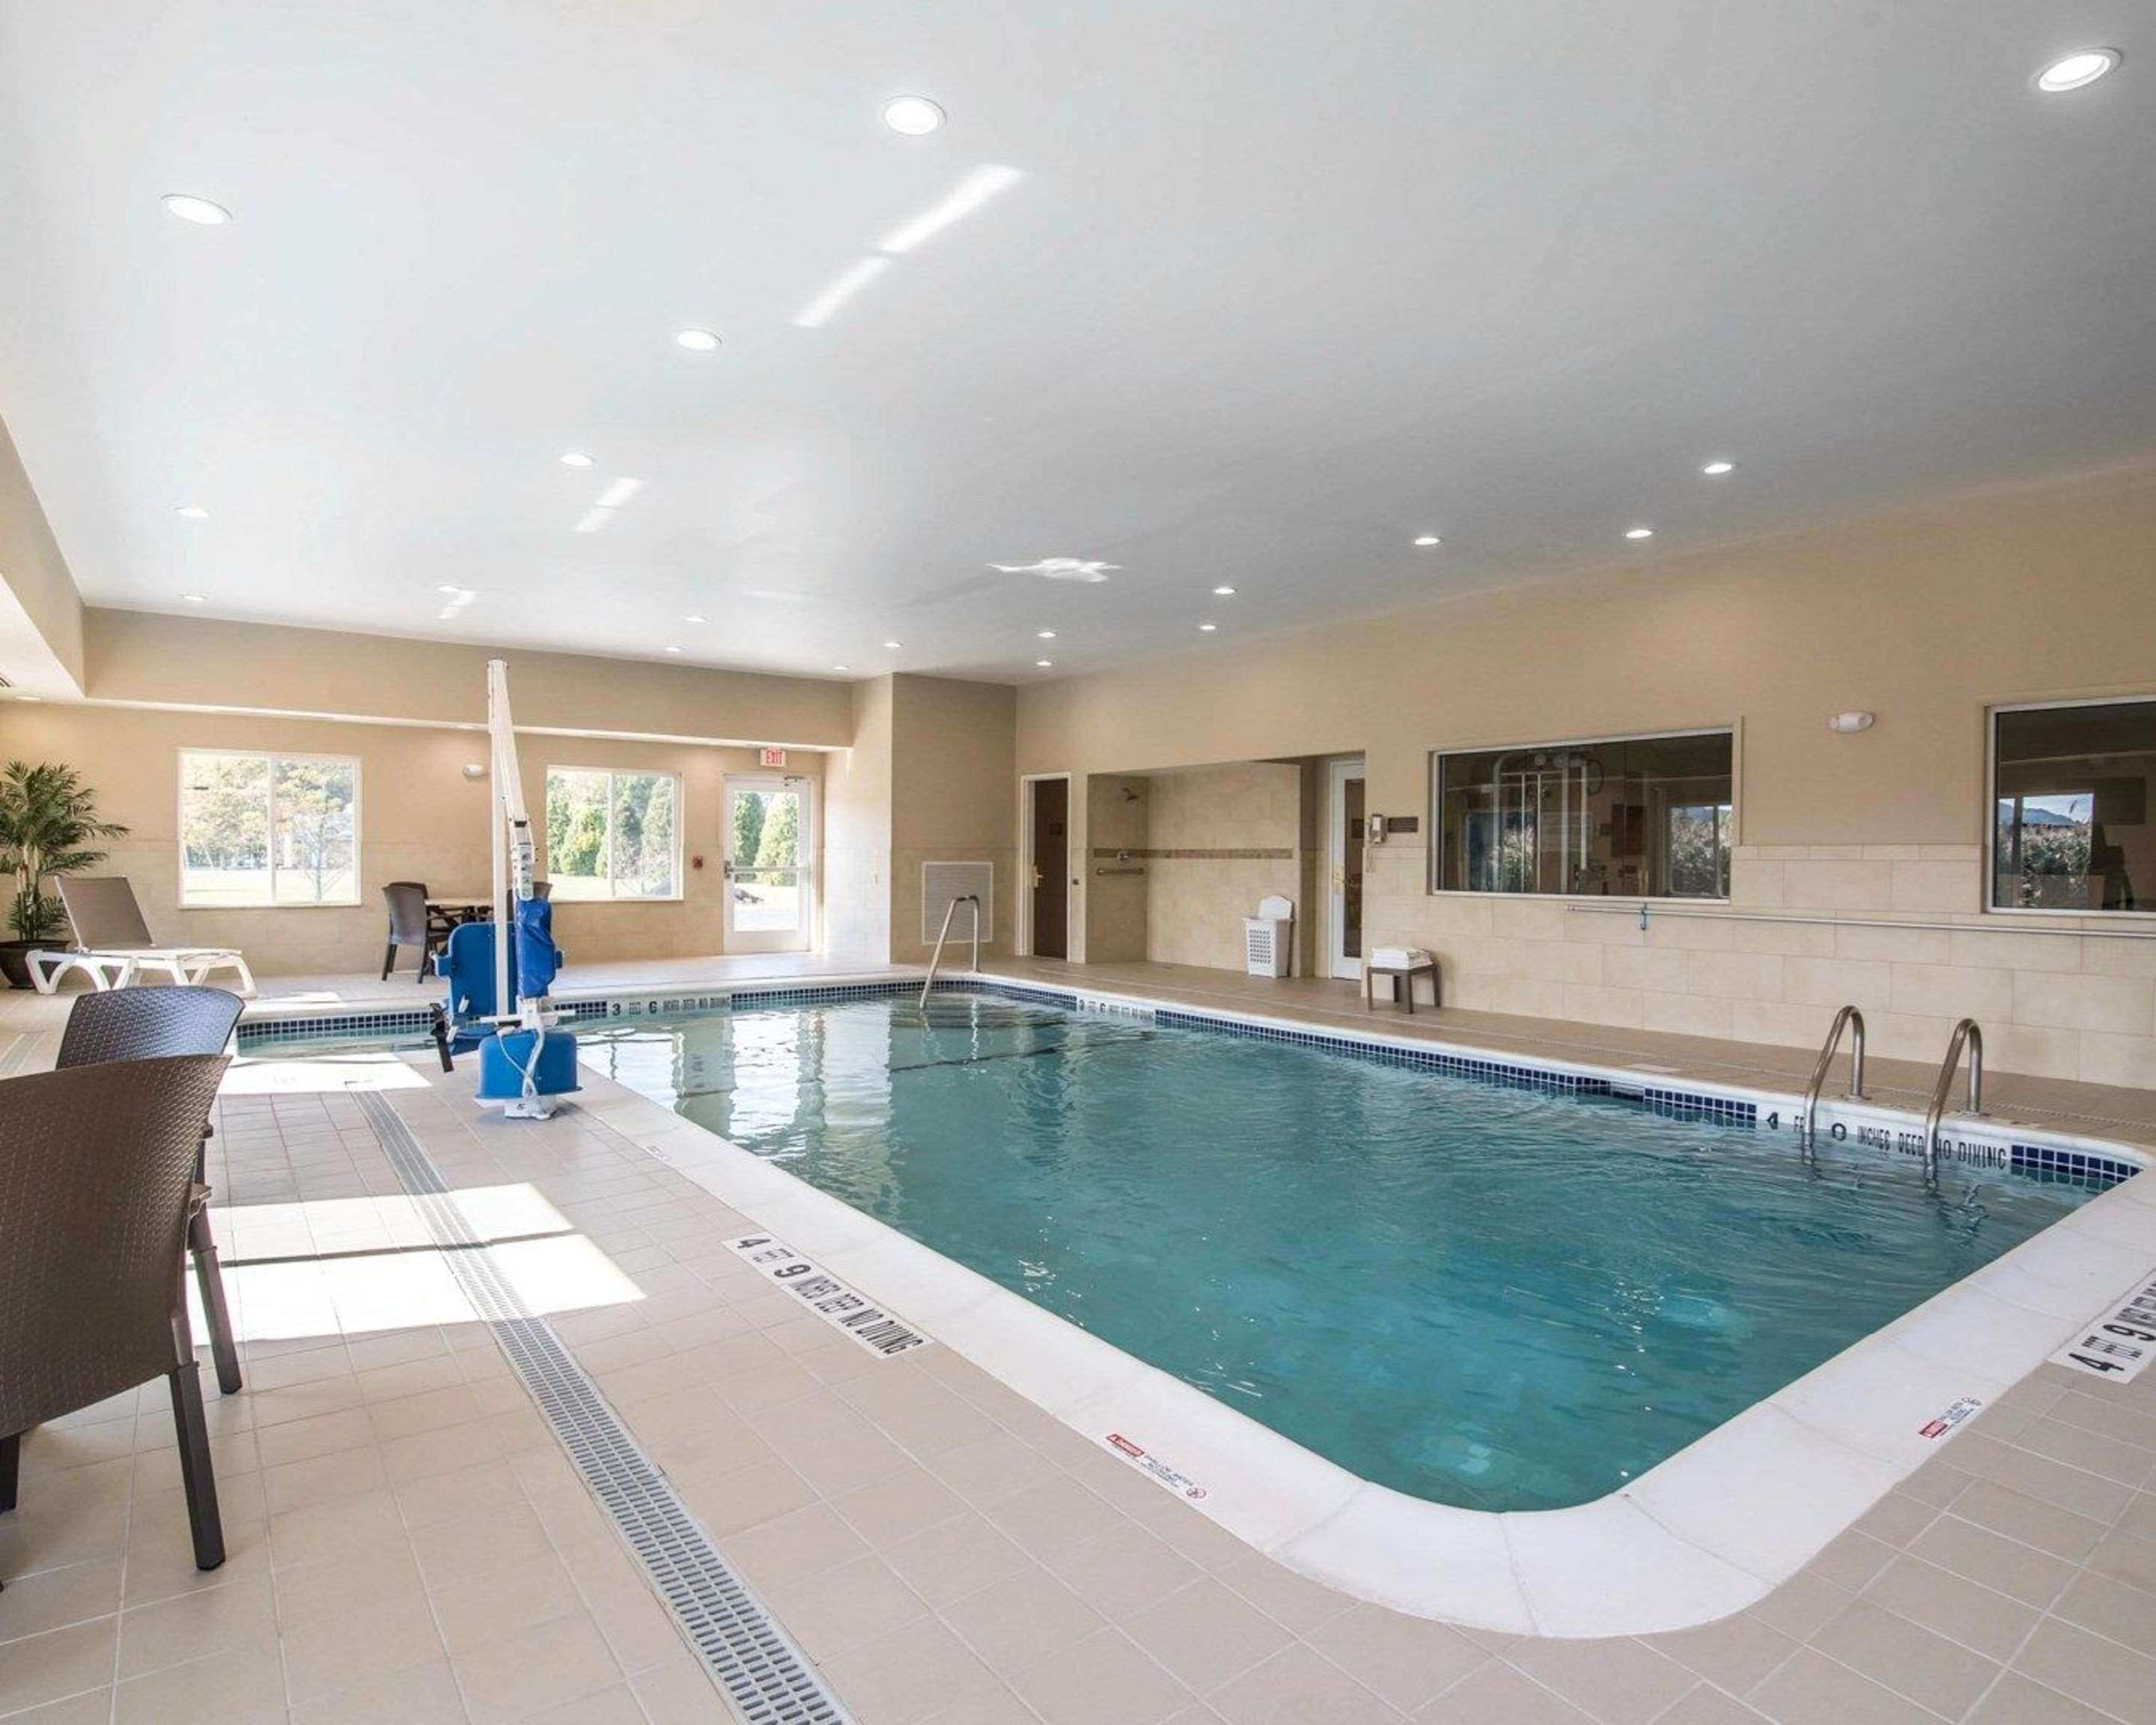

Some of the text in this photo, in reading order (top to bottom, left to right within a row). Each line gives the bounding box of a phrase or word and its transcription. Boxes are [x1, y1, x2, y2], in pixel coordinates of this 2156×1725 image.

[767, 750, 782, 764] EXIT
[612, 1003, 621, 1016] 3
[1857, 1125, 1890, 1151] INCHES
[1958, 1142, 2006, 1169] DIVING
[737, 1239, 771, 1249] 4
[774, 1265, 811, 1278] 9
[838, 1308, 883, 1327] NO
[855, 1320, 924, 1354] DIVING
[2068, 1352, 2125, 1372] 4
[2102, 1324, 2156, 1342] 9
